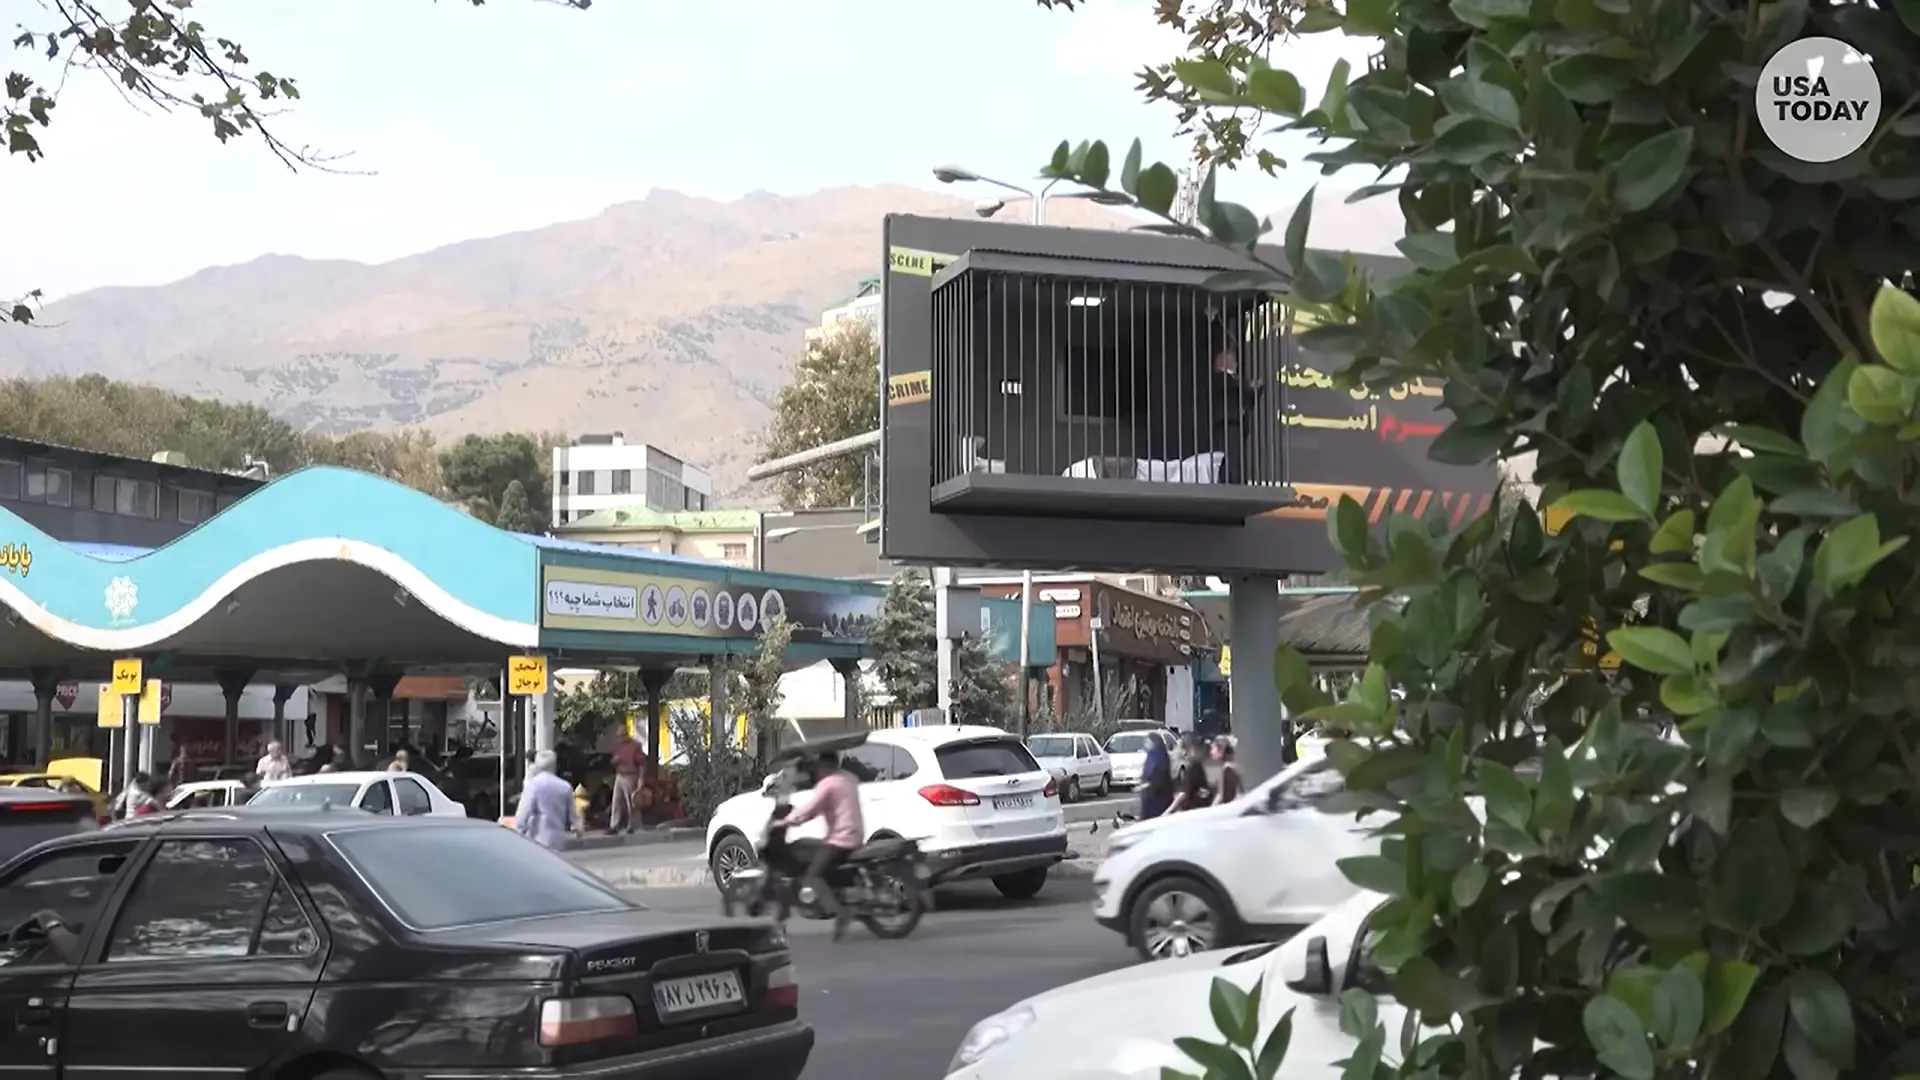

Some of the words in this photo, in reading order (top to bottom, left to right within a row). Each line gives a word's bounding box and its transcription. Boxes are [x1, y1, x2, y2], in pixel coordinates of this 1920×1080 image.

[888, 379, 929, 400] CRIME
[582, 590, 602, 607] شما
[602, 594, 635, 613] انتخاب
